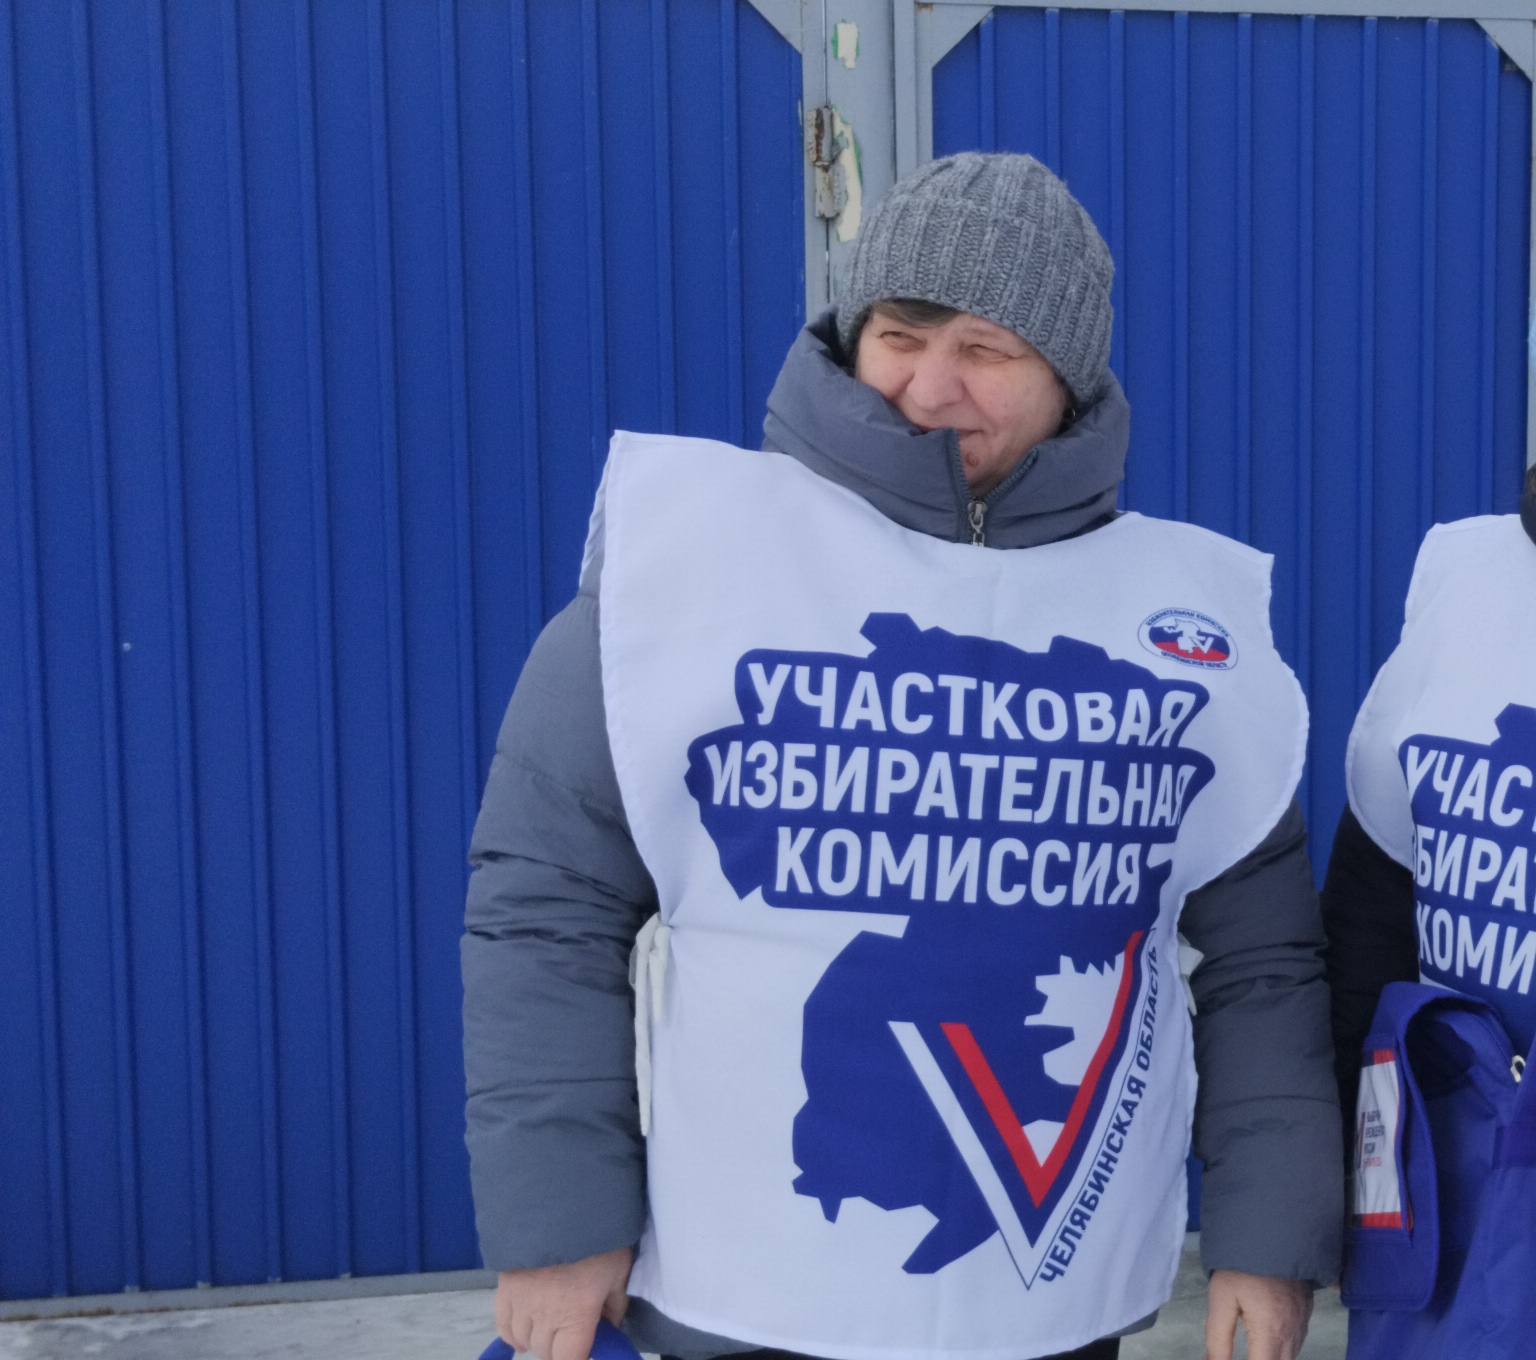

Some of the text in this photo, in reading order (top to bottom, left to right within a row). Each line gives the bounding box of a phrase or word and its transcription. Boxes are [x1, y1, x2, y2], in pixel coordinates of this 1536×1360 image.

[747, 662, 1197, 748] УЧАСТКОВАЯ
[704, 740, 1197, 828] ИЗБИРАТЕЛЬНАЯ
[775, 826, 1142, 906] КОМИССИЯ
[1039, 945, 1158, 1283] ЧЕЛЯБИНСКАЯ ОБЛАСТЬ
